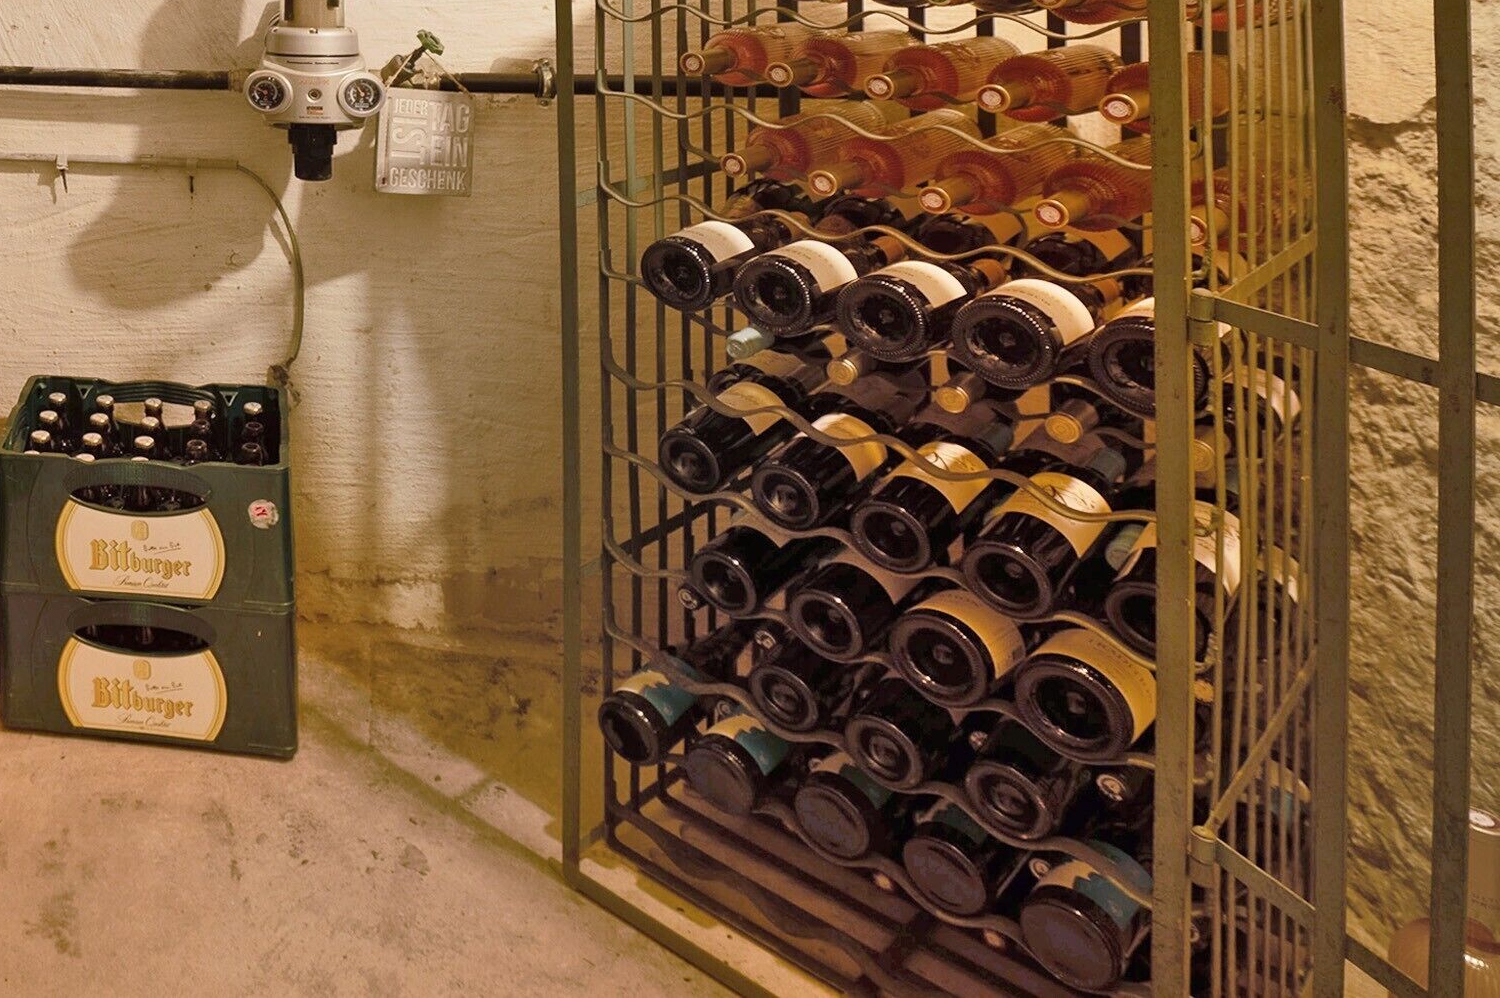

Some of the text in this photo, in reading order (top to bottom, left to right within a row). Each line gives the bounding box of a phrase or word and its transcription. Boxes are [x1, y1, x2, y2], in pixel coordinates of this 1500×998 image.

[394, 98, 470, 133] JEDER TAG
[430, 134, 468, 167] EIN
[389, 167, 467, 190] GESCHENK
[89, 538, 192, 580] Bitburger
[91, 677, 194, 720] Bitburger
